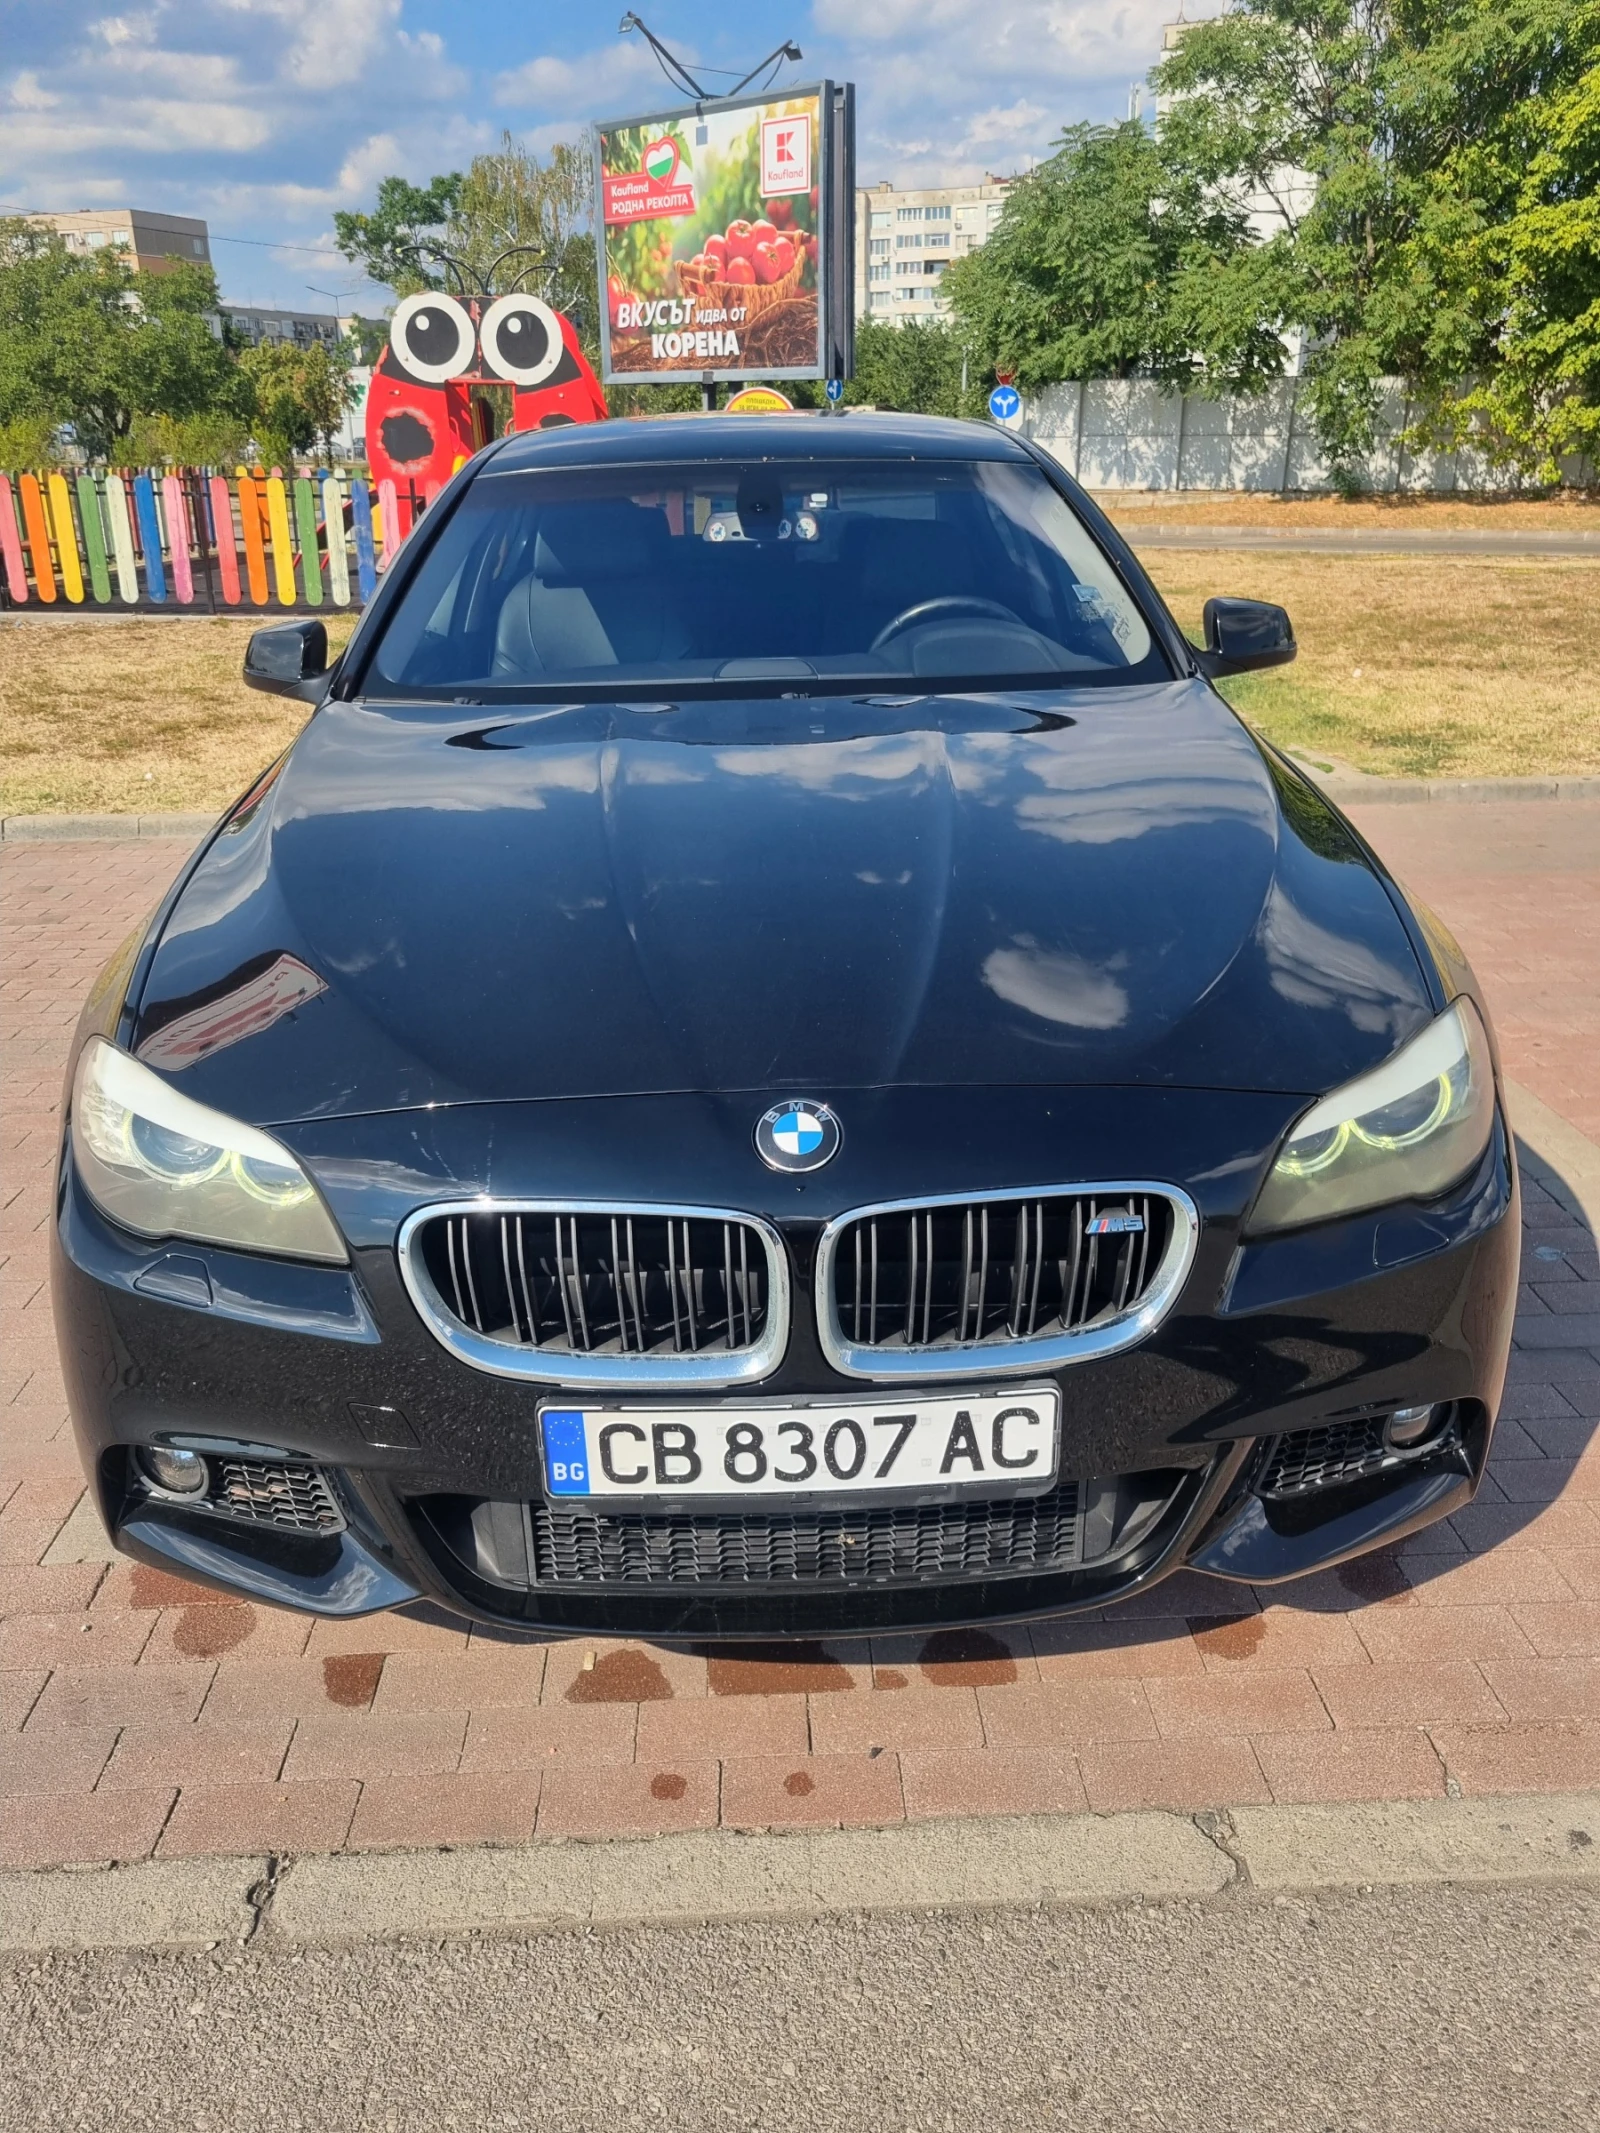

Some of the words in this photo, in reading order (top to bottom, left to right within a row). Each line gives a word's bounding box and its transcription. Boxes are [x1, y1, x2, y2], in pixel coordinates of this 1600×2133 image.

[767, 167, 804, 181] Kaufland
[611, 181, 649, 197] Kaufland
[612, 199, 645, 215] РОДНА
[646, 193, 689, 210] РЕКОЛТА
[617, 298, 696, 329] ВКУСЪТ
[695, 308, 728, 325] ИДВА
[730, 307, 747, 322] ОТ
[651, 330, 740, 359] КОРЕНА
[764, 1102, 831, 1124] BMW
[598, 1422, 702, 1486] CB
[723, 1413, 919, 1485] 8307
[938, 1406, 1041, 1474] AC
[553, 1462, 585, 1481] BG
